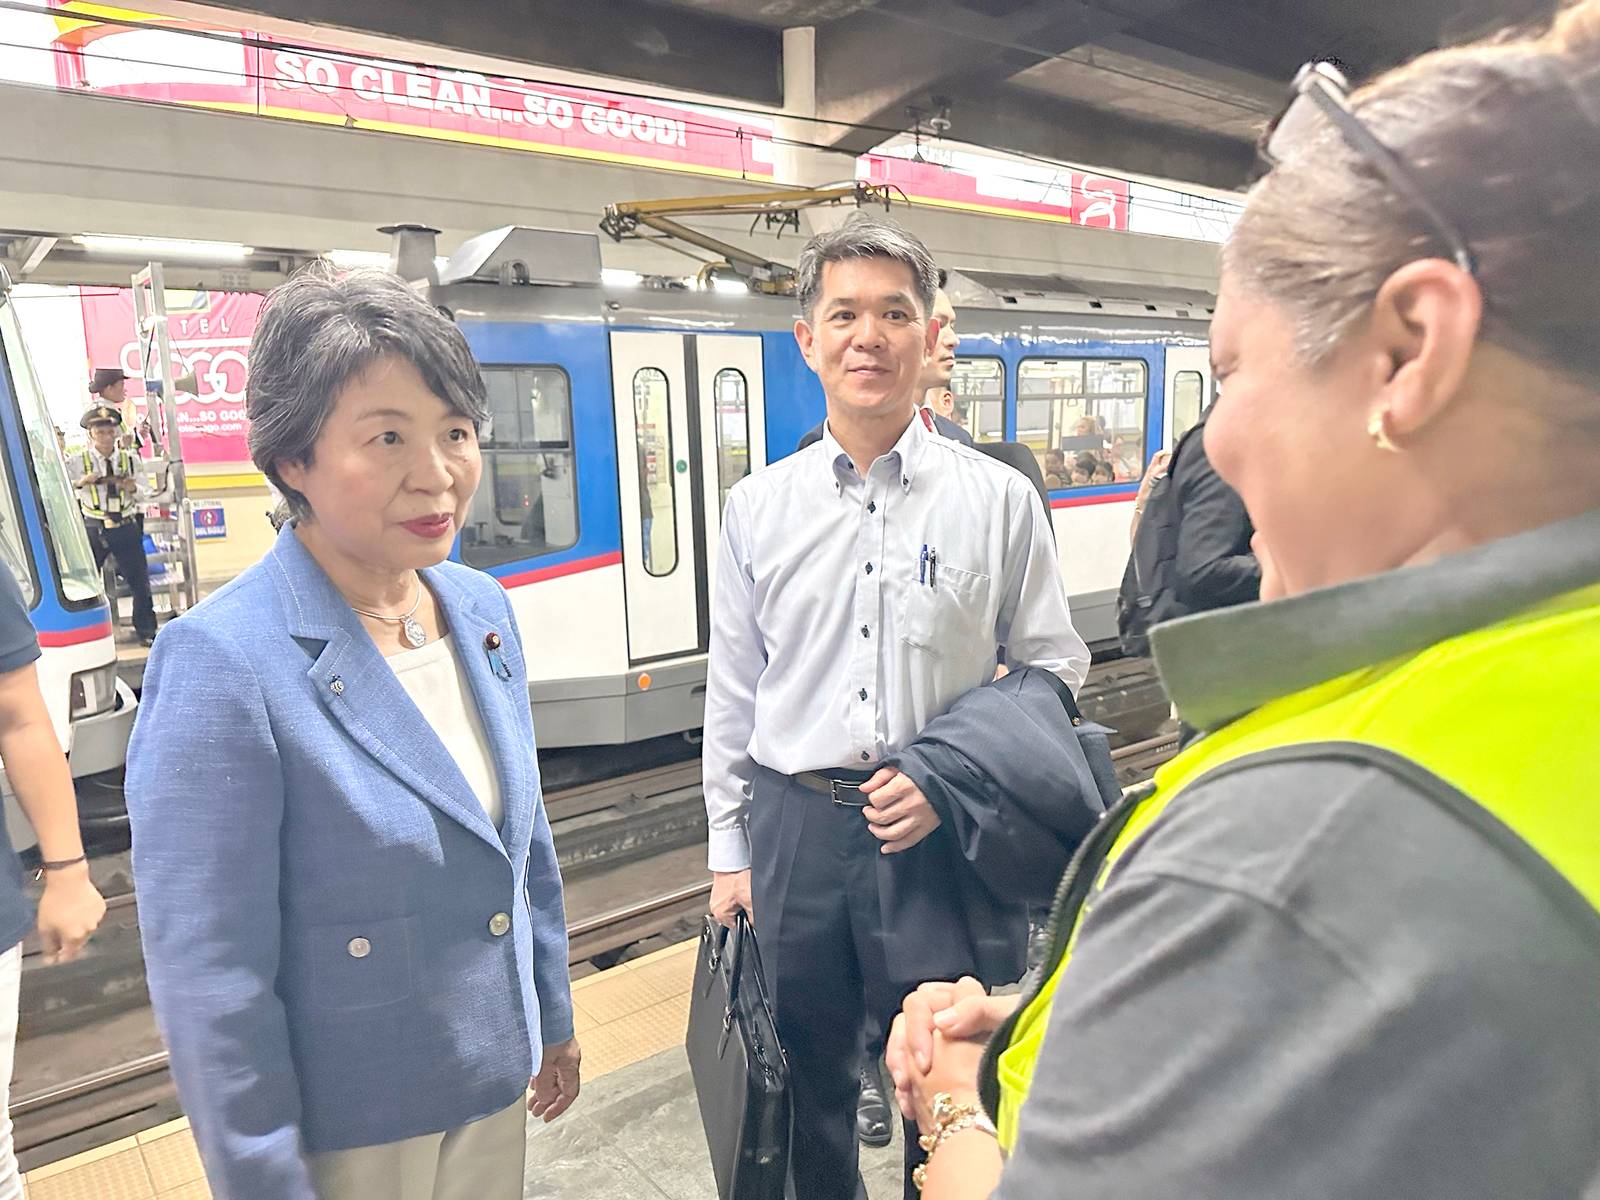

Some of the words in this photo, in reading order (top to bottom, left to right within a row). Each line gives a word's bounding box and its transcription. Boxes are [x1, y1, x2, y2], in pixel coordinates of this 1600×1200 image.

[274, 51, 340, 95] SO
[581, 102, 687, 147] GOOD!
[179, 317, 230, 335] TEL
